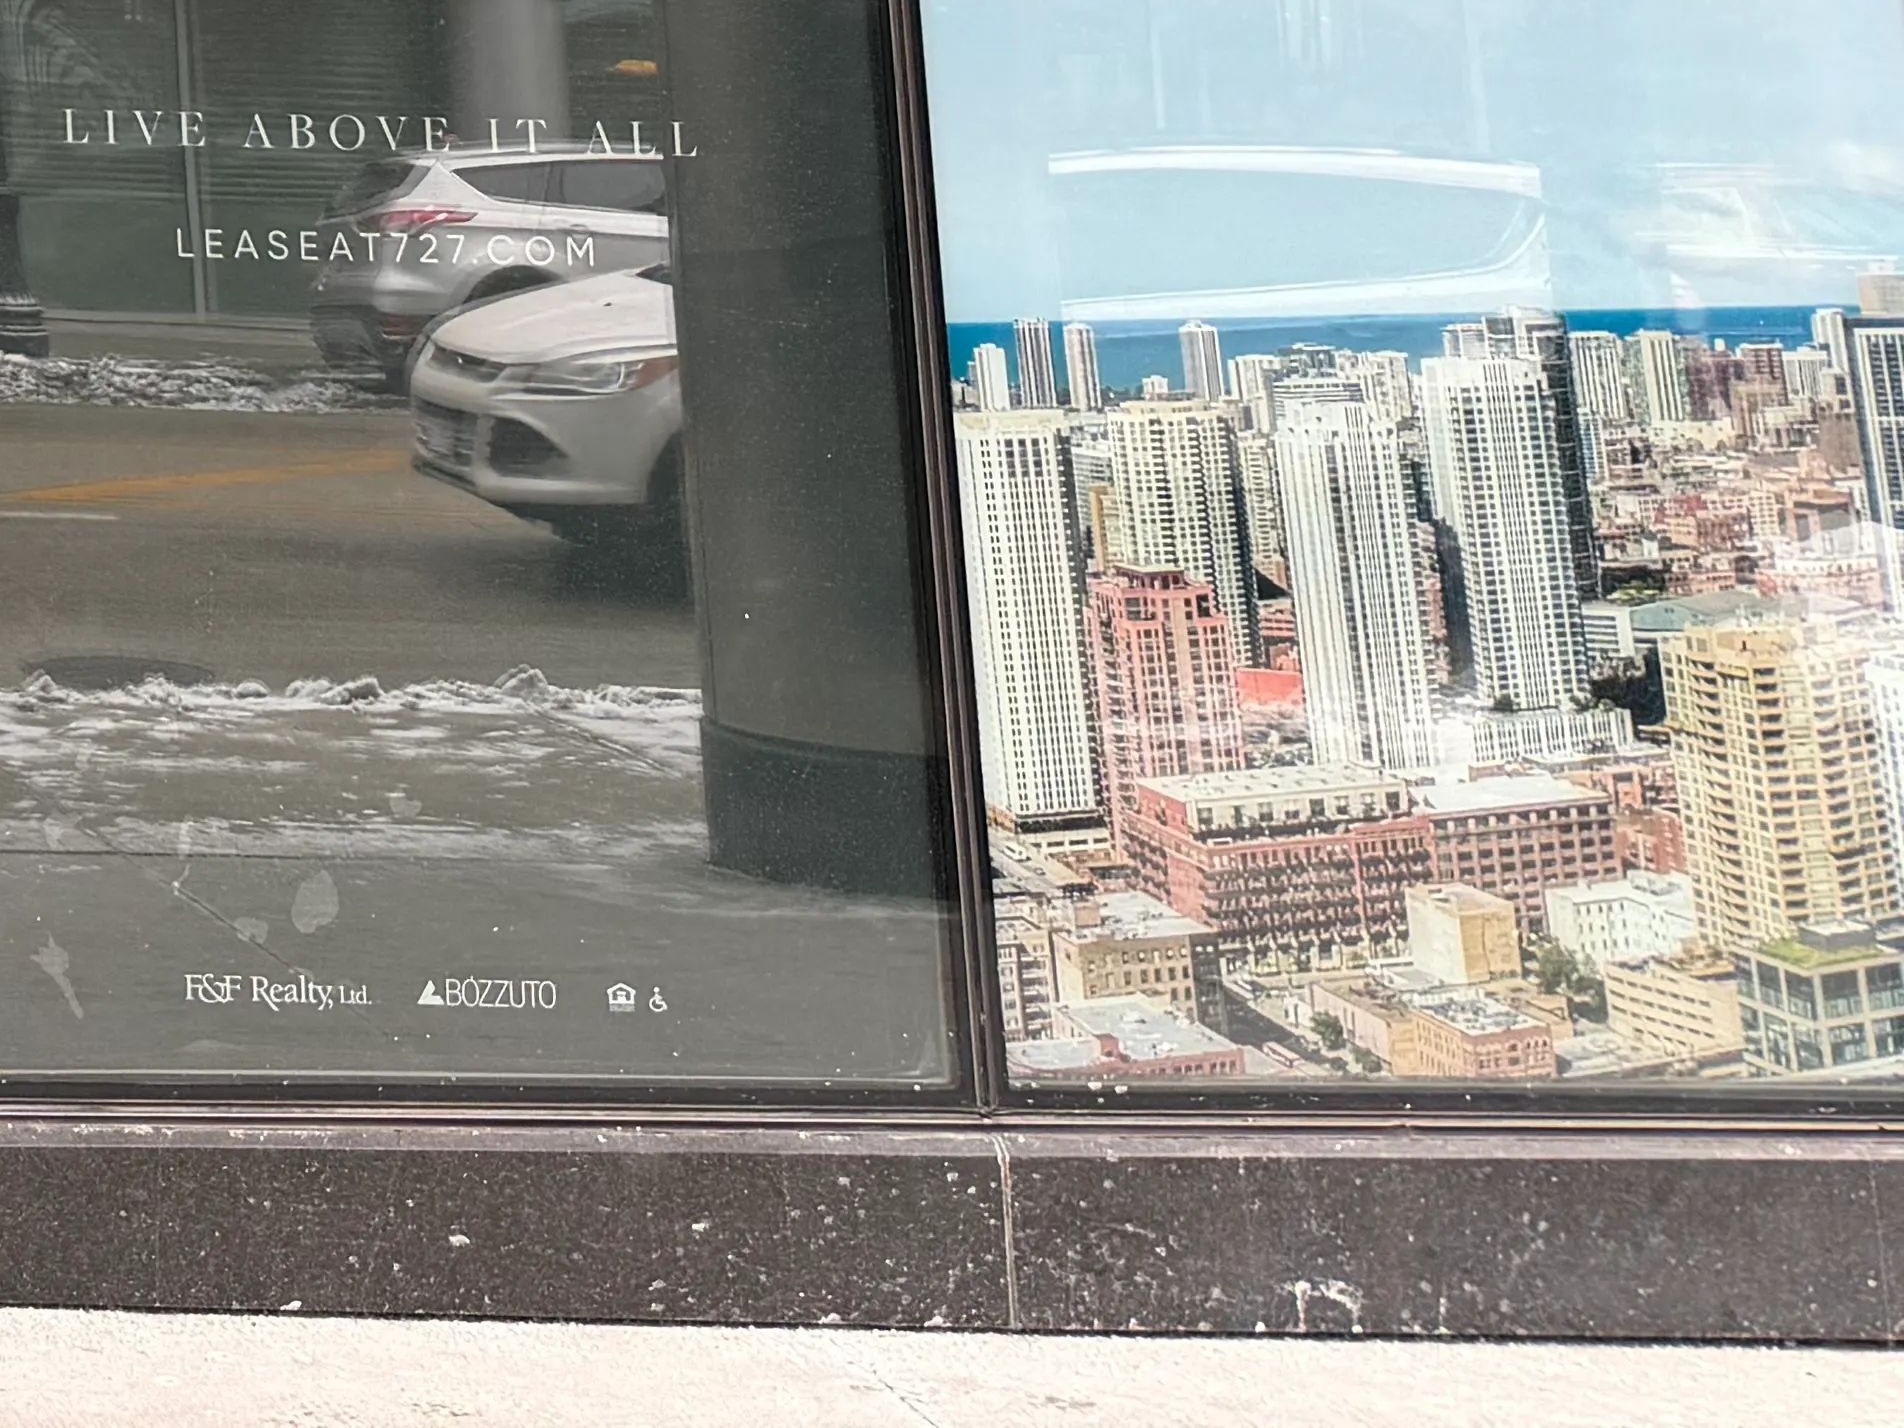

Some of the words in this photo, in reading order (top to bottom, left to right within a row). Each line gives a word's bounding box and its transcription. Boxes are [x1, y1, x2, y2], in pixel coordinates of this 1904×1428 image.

[62, 108, 205, 148] LIVE
[244, 112, 453, 153] ABOVE
[490, 118, 547, 155] IT
[587, 119, 700, 158] ALL
[176, 227, 596, 267] LEASEAT727.COM
[184, 974, 242, 1003] F&F
[251, 976, 334, 1012] Realty,
[339, 986, 374, 1006] Ltd.
[445, 978, 558, 1010] BOZZUTO
